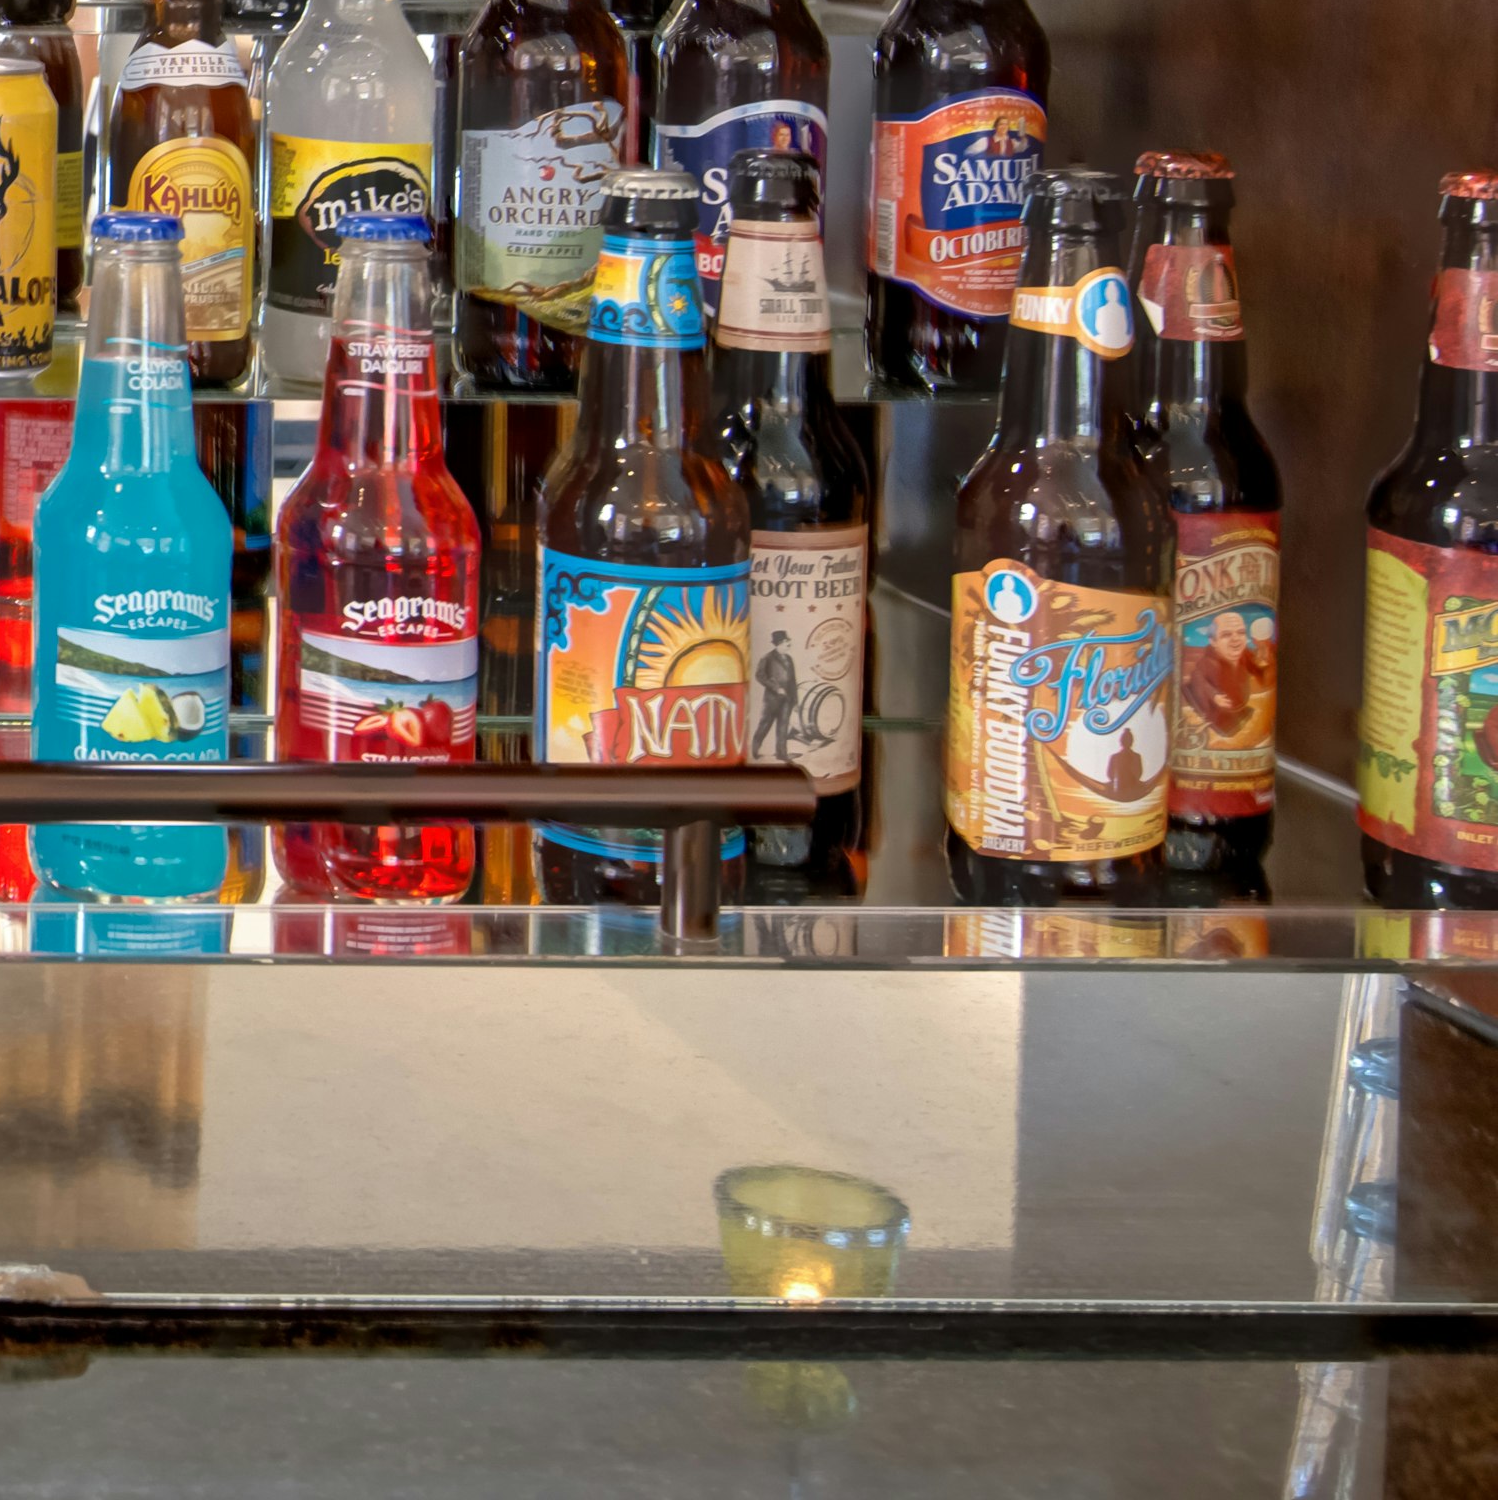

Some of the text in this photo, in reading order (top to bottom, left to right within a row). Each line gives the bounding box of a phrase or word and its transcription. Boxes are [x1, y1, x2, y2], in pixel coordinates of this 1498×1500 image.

[159, 57, 225, 66] VANILLA
[143, 67, 183, 76] WHITE
[933, 154, 1039, 185] SAMUEL
[142, 172, 241, 224] KAHLÚA
[502, 187, 590, 205] ANGRY
[941, 182, 1023, 211] ADAM
[313, 183, 424, 232] mike's
[488, 206, 602, 226] ORCHARD
[515, 229, 544, 237] HARD
[507, 246, 584, 257] CRISP APPLE
[1016, 295, 1073, 324] FUNKY
[347, 340, 431, 360] STRAWBERRY
[126, 359, 184, 376] CALYPSO
[360, 357, 423, 375] DAIQUIRI
[128, 375, 184, 391] COLADA
[775, 555, 814, 580] Your
[93, 589, 215, 626] Seagram's
[341, 594, 467, 632] Seagram's
[128, 618, 188, 631] ESCAPES
[377, 623, 440, 638] ESCAPES
[982, 624, 1031, 835] FUNKY BUDDHA
[1457, 830, 1495, 845] INLET
